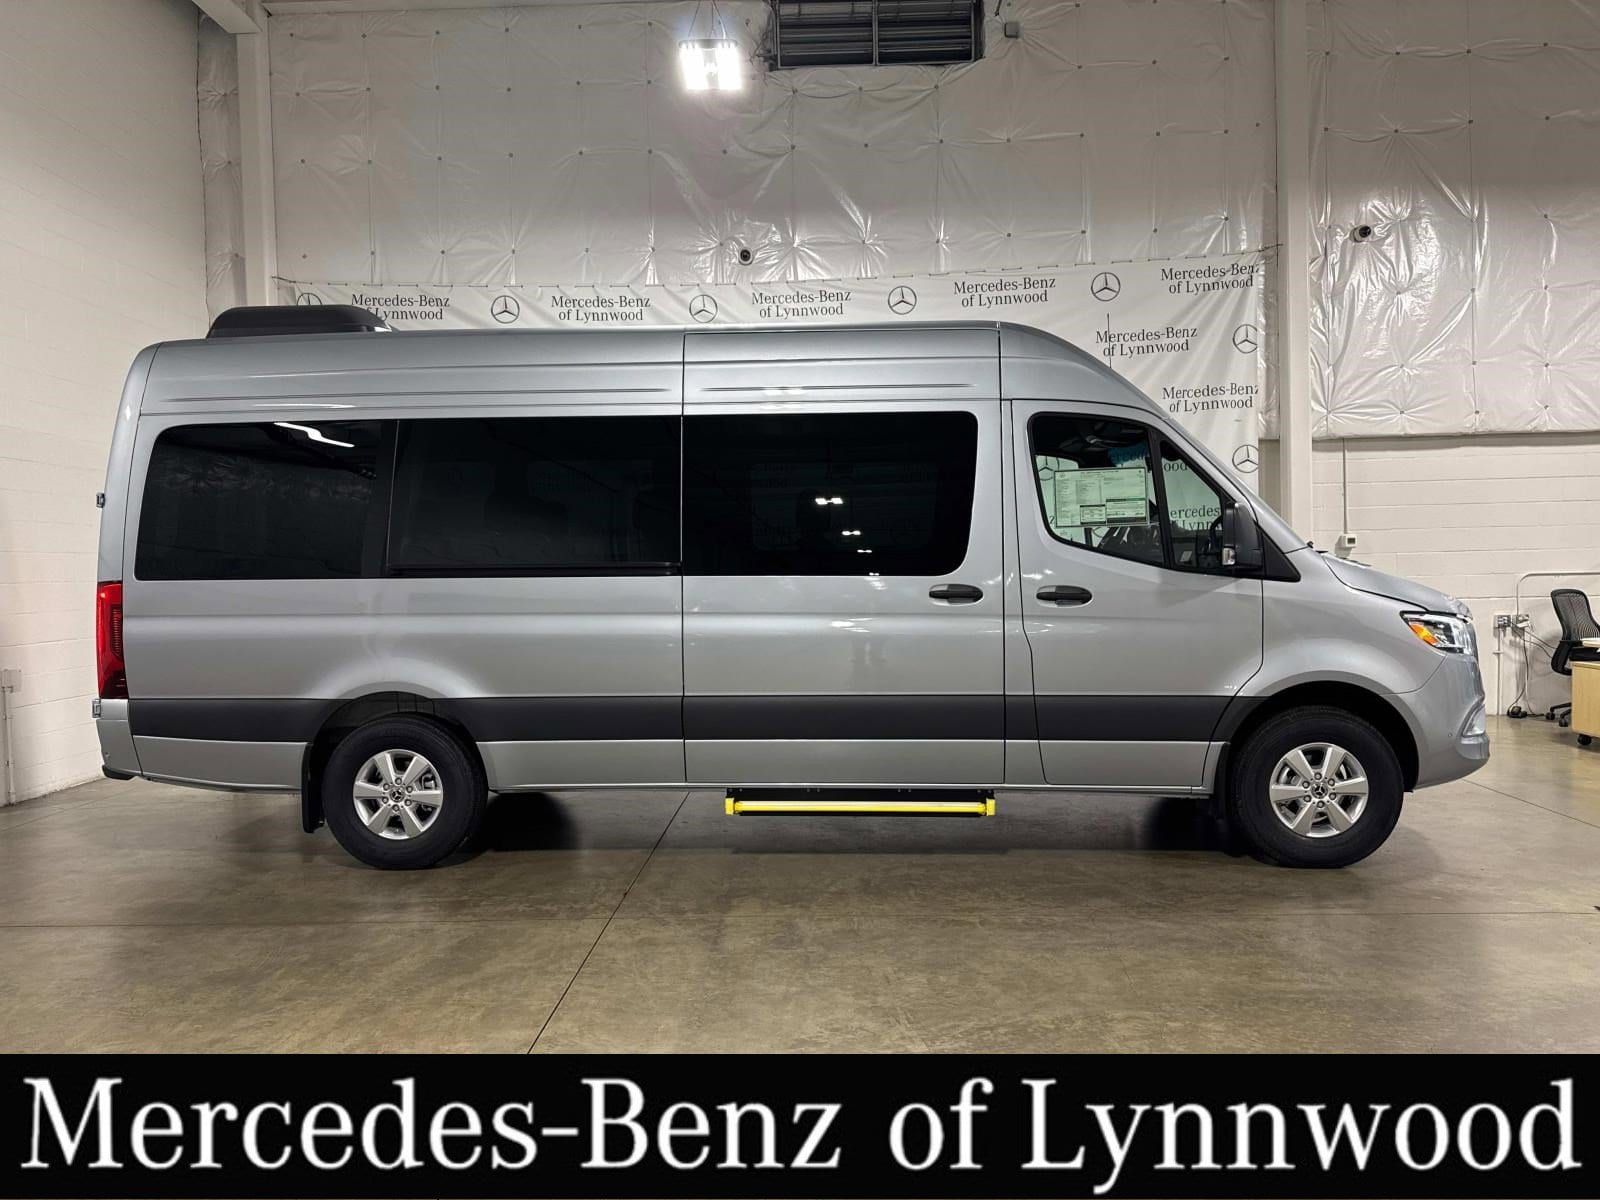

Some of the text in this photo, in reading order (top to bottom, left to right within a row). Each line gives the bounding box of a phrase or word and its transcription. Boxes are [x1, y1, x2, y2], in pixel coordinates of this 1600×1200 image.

[954, 277, 1056, 294] Mercedes-Benz
[1168, 275, 1254, 295] of Lynnwood
[351, 293, 450, 307] Mercedes-Benz
[551, 295, 651, 308] Mercedes-Benz
[751, 289, 852, 305] Mercedes-Benz
[961, 289, 1049, 309] of Lynnwood
[558, 308, 643, 324] of Lynnwood
[759, 302, 844, 320] of Lynnwood
[1096, 326, 1198, 344] Mercedes-Benz
[1103, 338, 1189, 359] of Lynnwood
[1169, 395, 1253, 414] of Lynnwood
